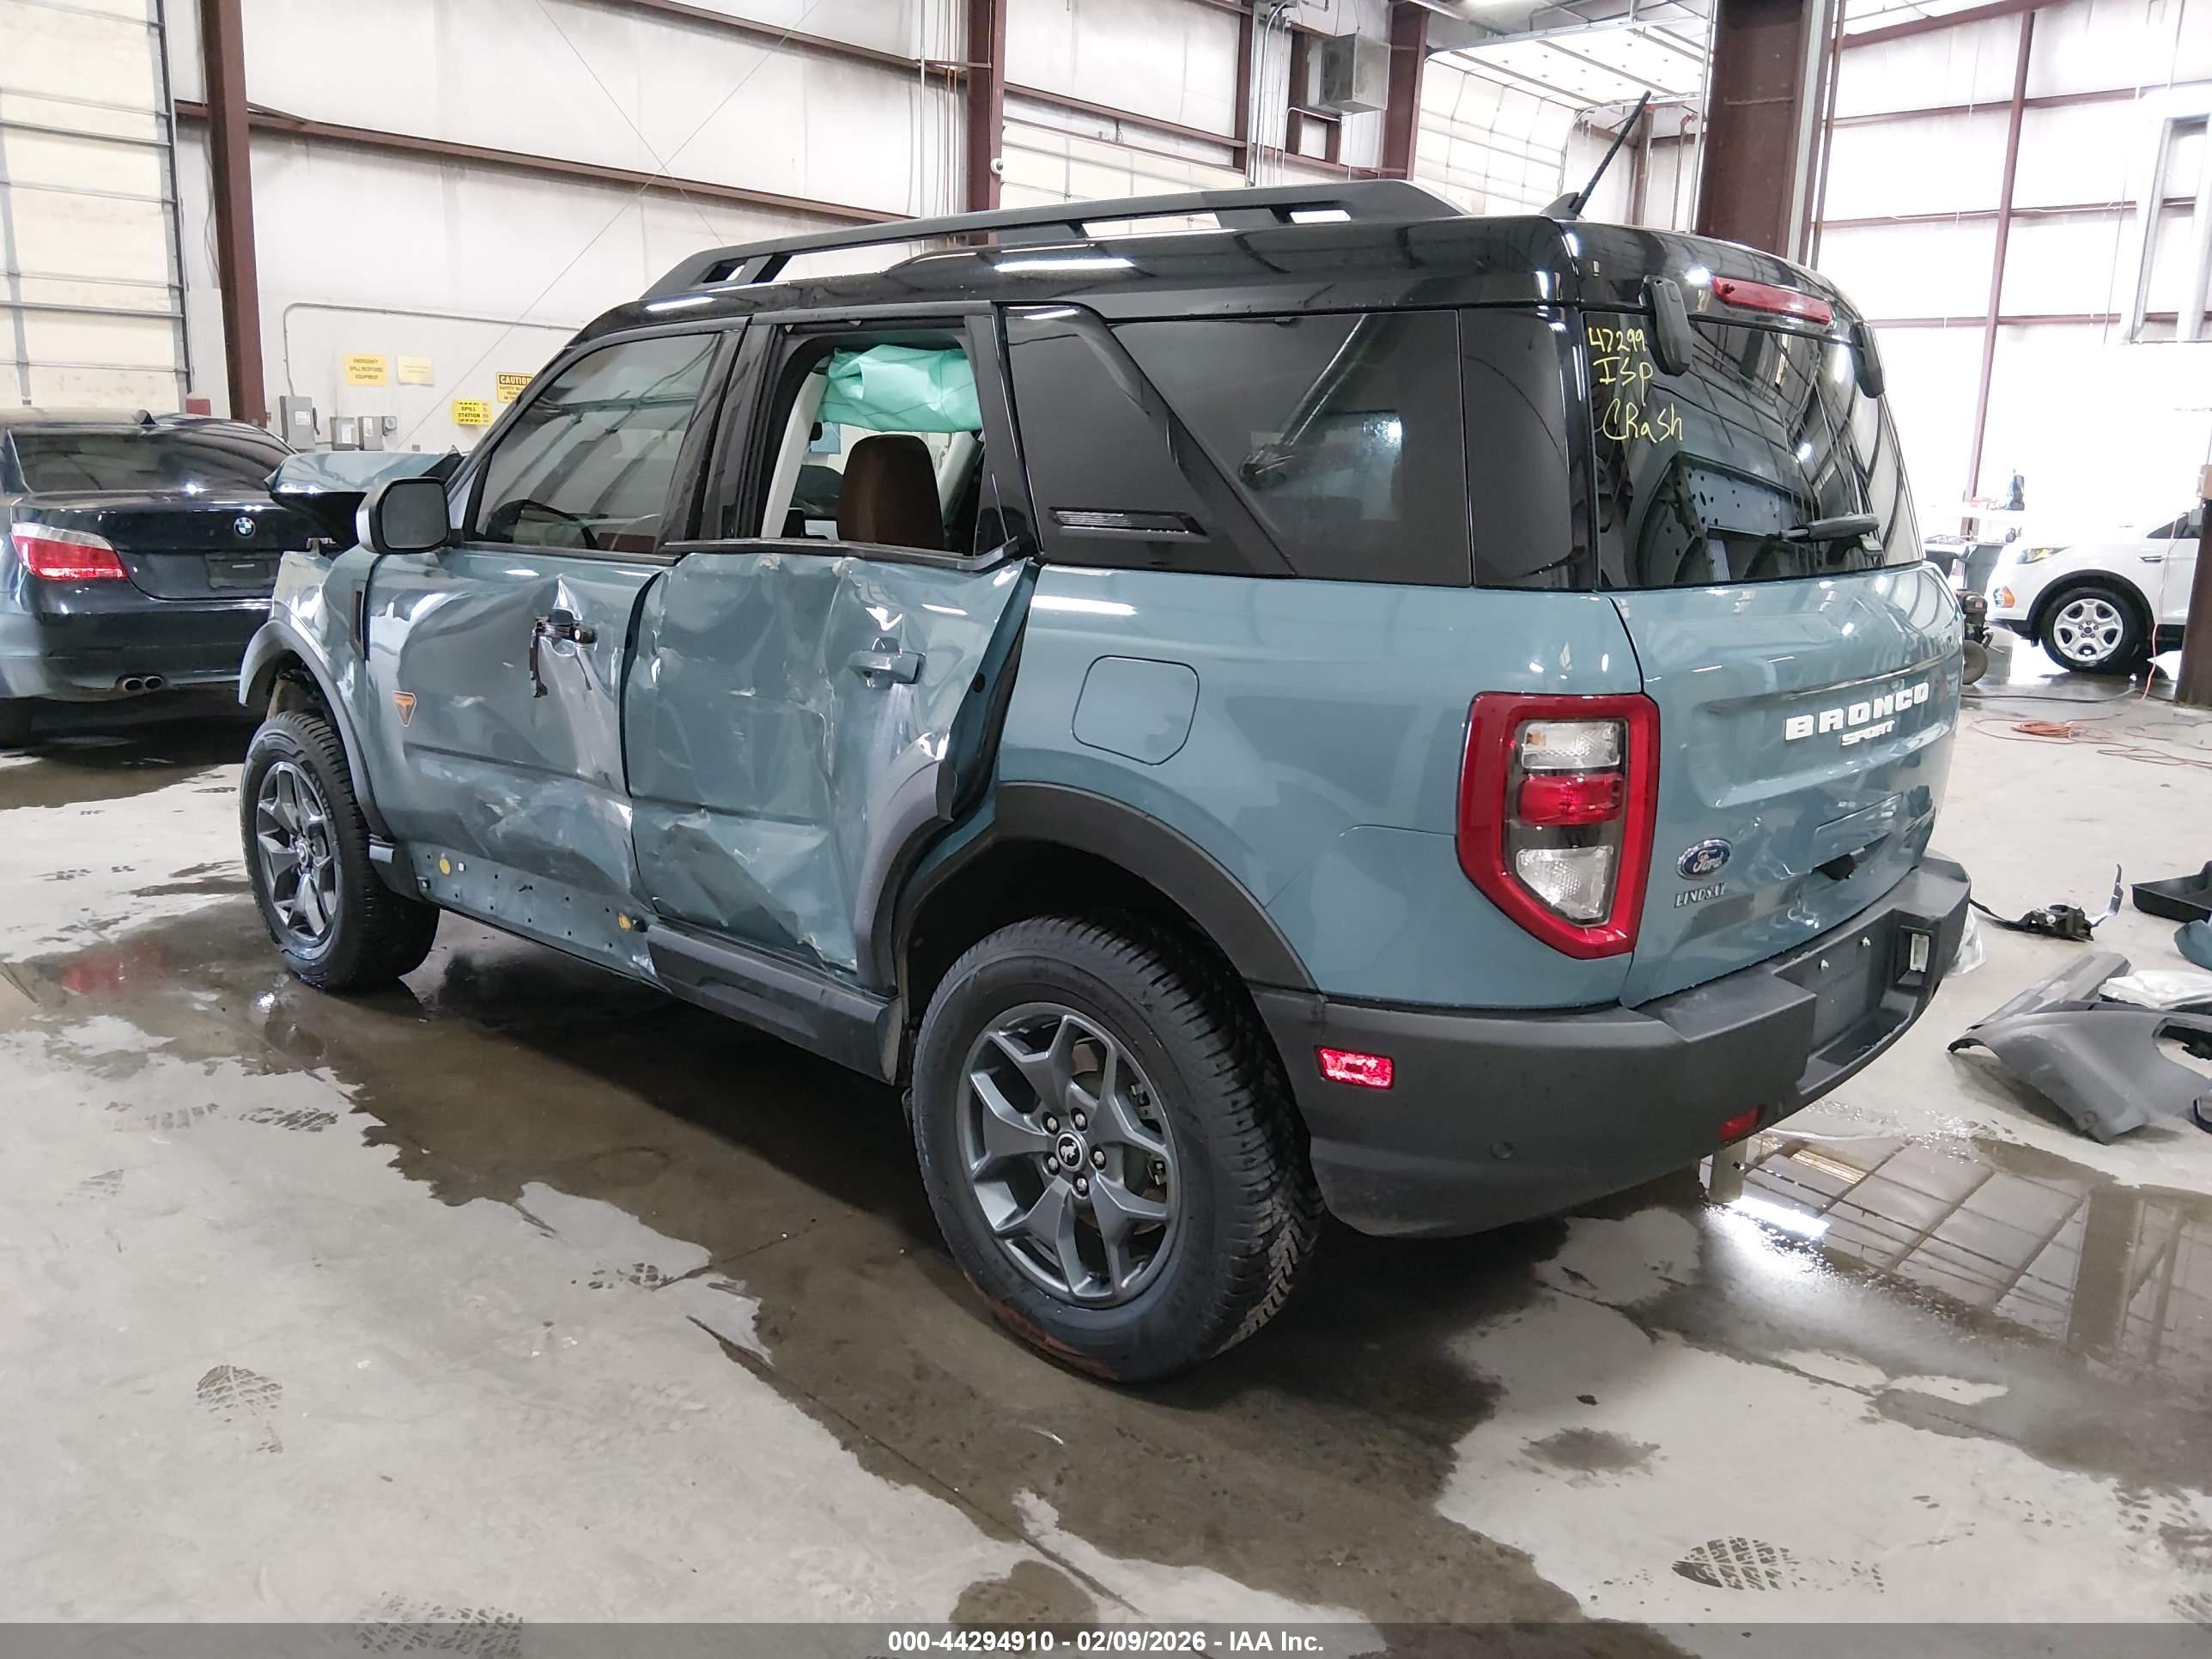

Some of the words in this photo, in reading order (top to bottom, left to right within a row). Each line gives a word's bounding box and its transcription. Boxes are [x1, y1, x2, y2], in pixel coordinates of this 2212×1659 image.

[1589, 327, 1647, 352] 47299
[1785, 682, 1929, 741] BRONCO
[1841, 720, 1895, 746] SPORT
[1692, 848, 1725, 873] Ford
[1674, 882, 1727, 908] LINDSAY
